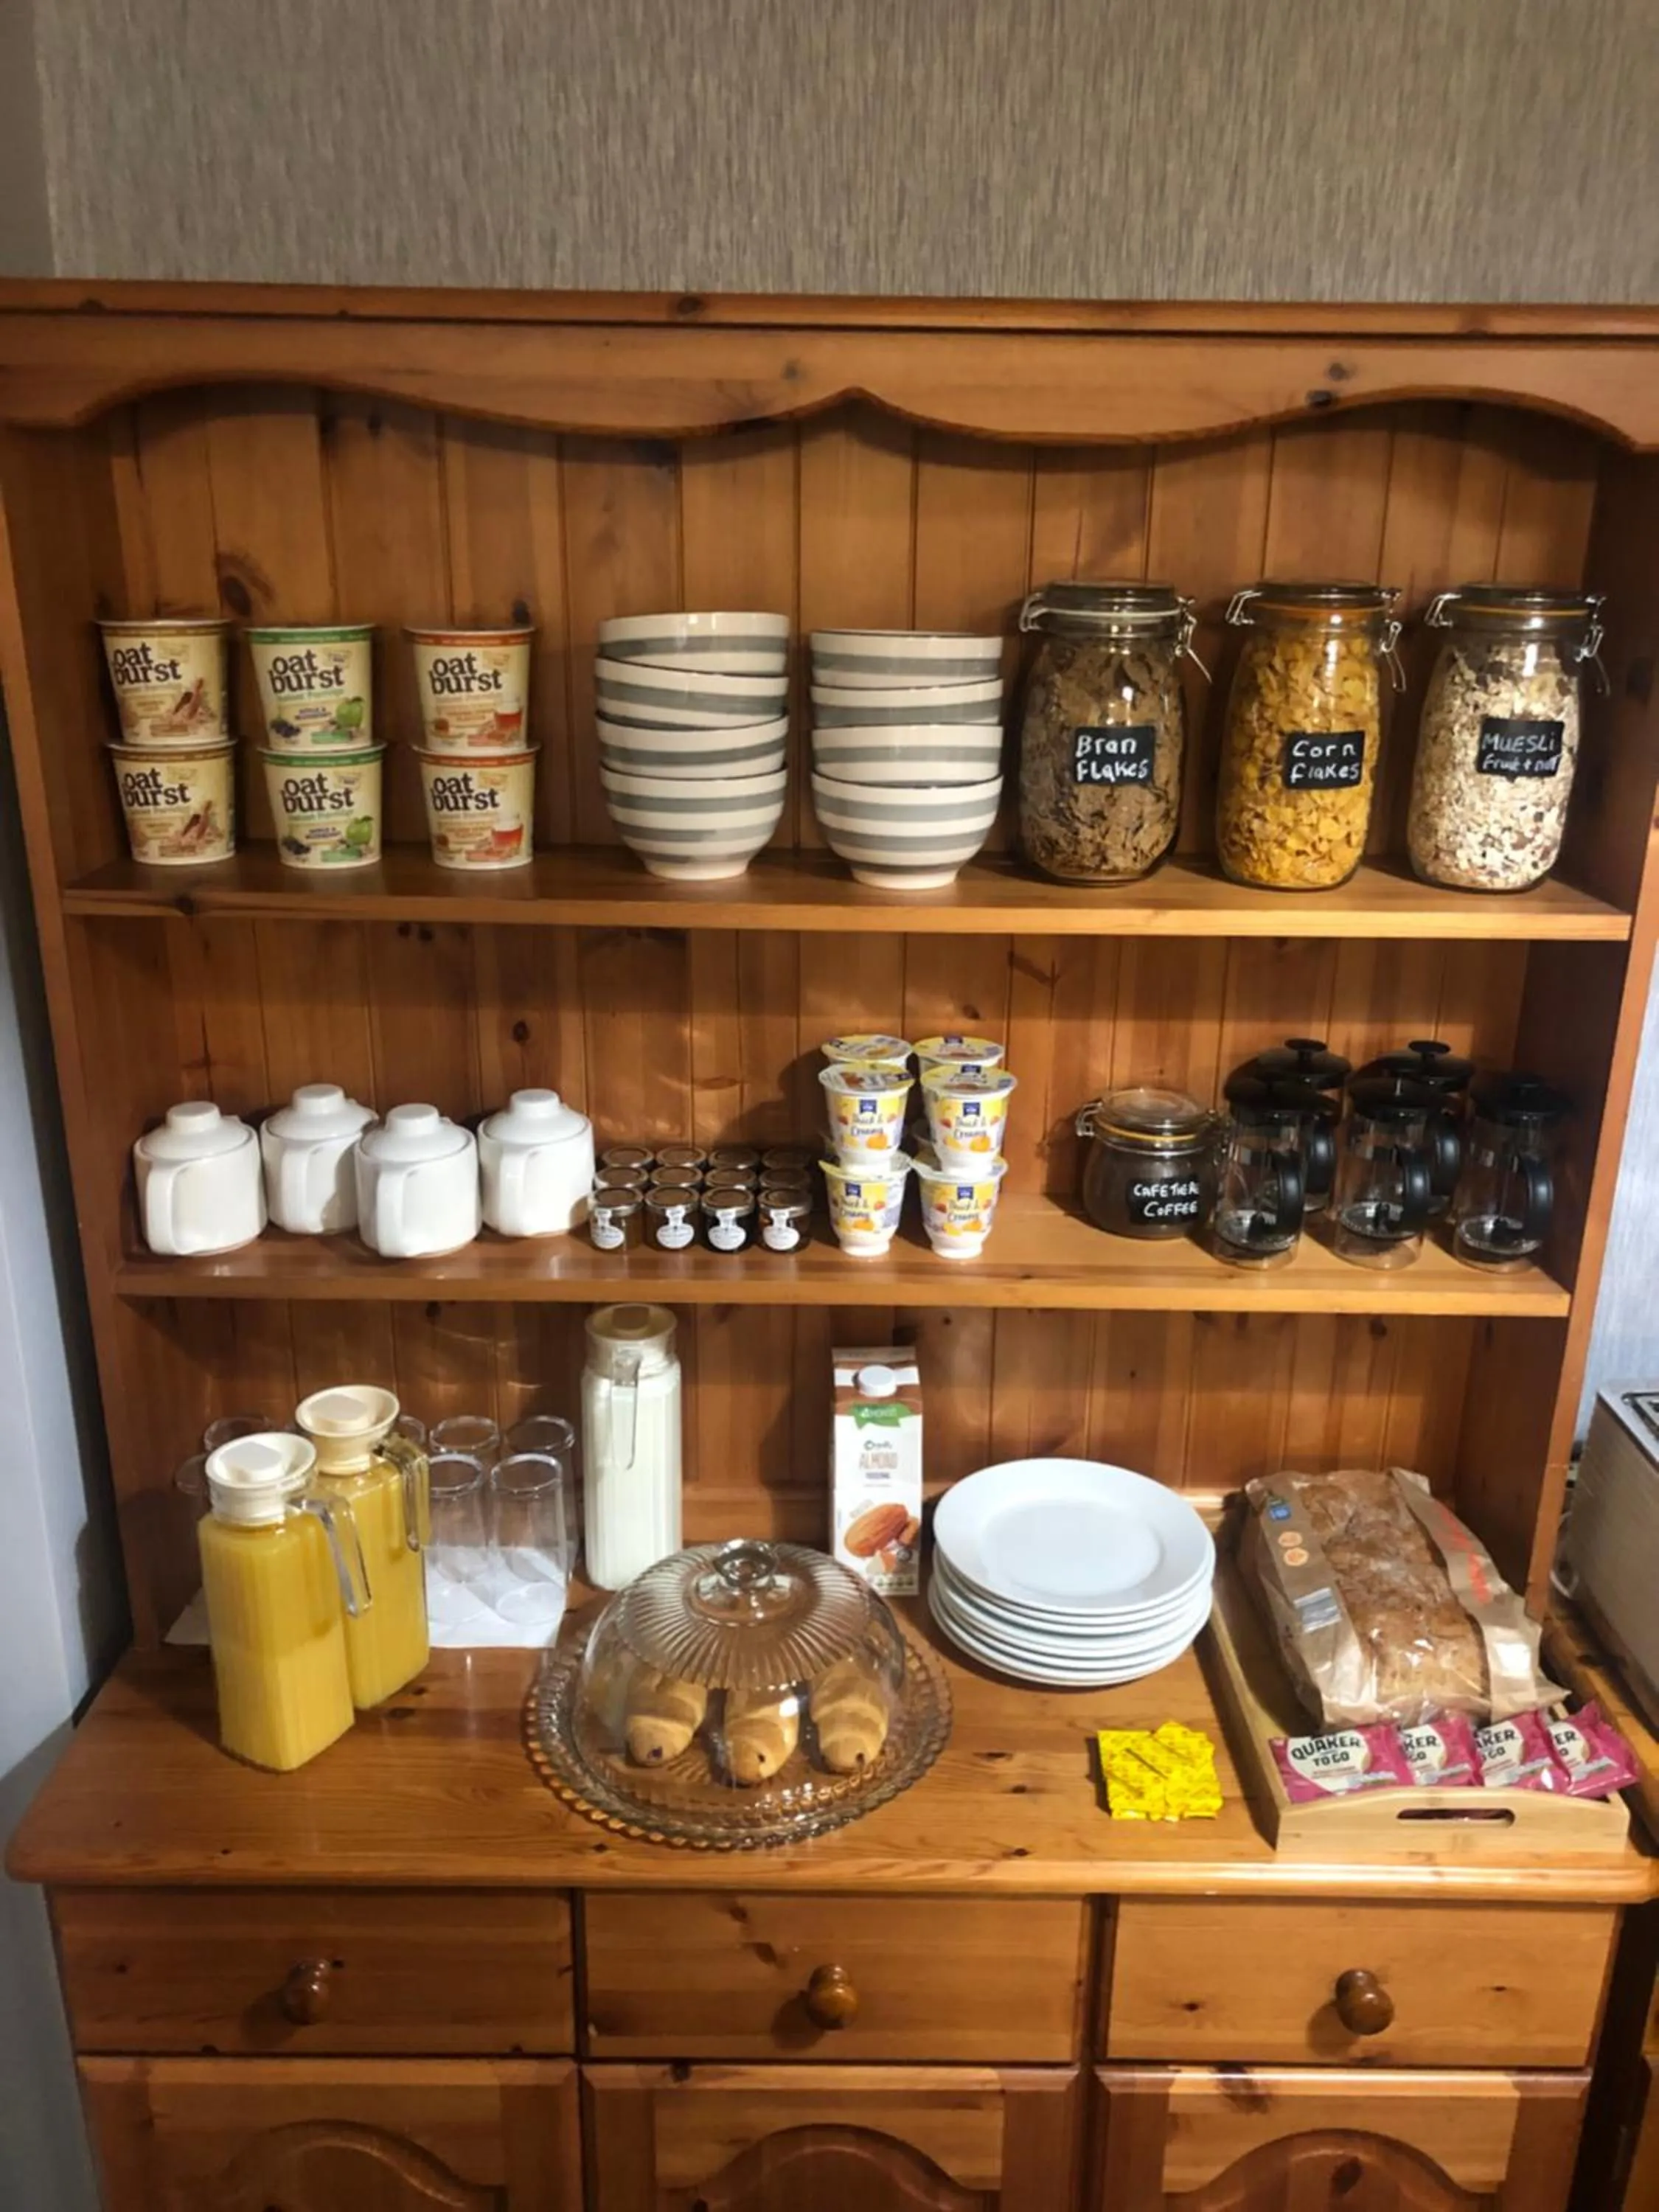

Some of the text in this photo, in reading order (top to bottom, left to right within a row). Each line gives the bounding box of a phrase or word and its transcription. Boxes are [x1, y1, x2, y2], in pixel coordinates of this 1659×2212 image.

[114, 641, 153, 667] oat
[272, 649, 318, 675] oat
[432, 652, 478, 677] oat
[268, 665, 345, 693] burst
[428, 669, 503, 694] burst
[1075, 735, 1137, 757] Bran
[1293, 740, 1356, 758] Corn
[123, 768, 163, 790] oat
[283, 773, 329, 796] oat
[434, 772, 474, 795] oat
[122, 783, 191, 807] burst
[280, 787, 355, 813] burst
[430, 787, 500, 811] burst
[1291, 1736, 1360, 1761] QUAKER
[1313, 1756, 1330, 1767] TO
